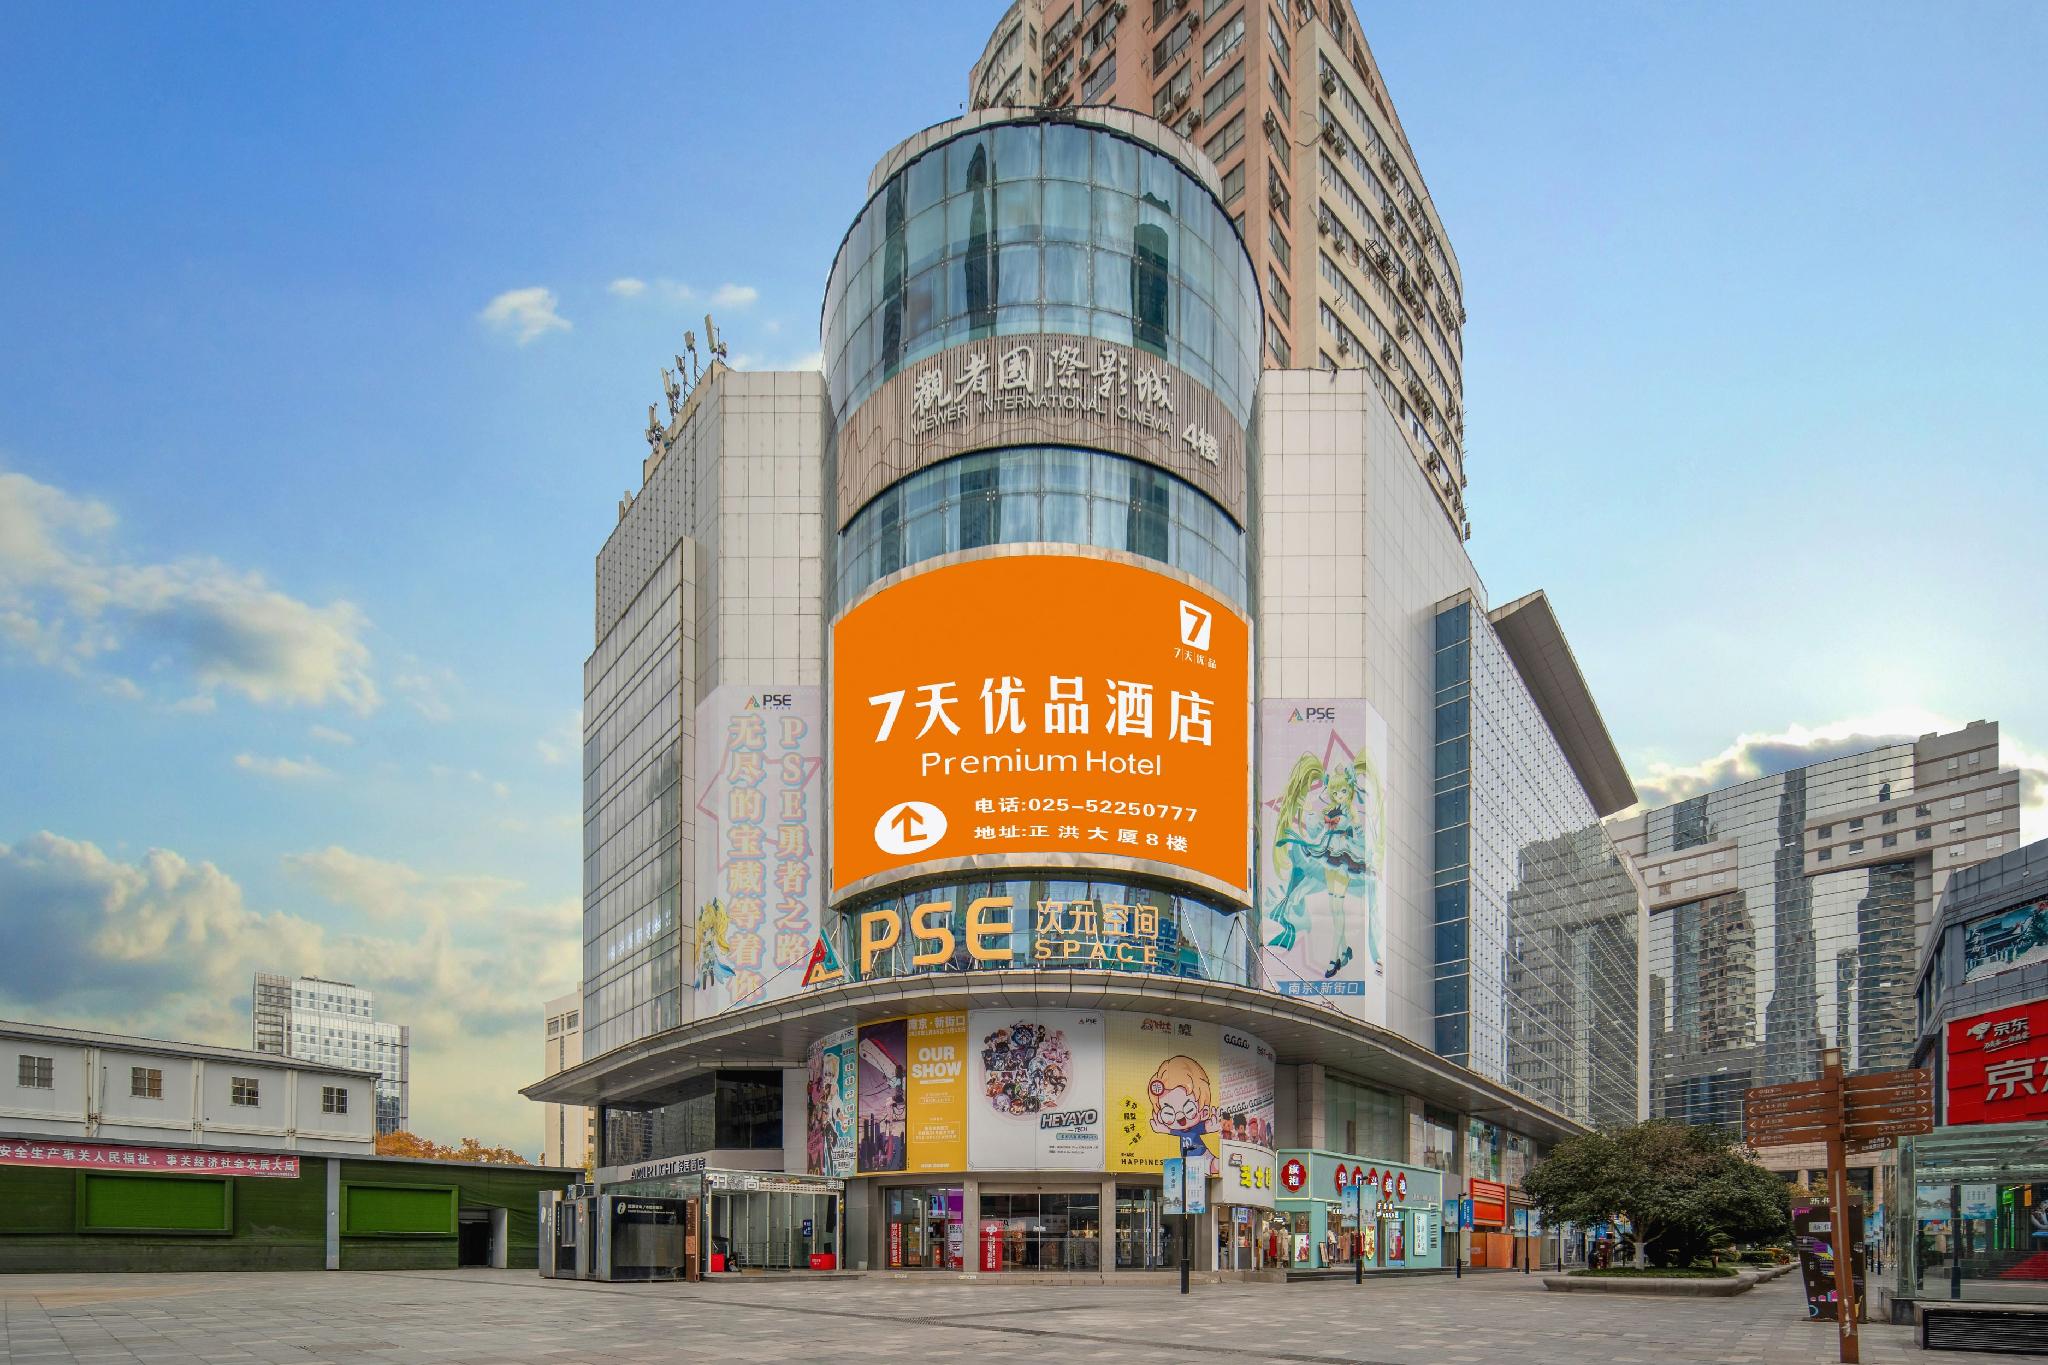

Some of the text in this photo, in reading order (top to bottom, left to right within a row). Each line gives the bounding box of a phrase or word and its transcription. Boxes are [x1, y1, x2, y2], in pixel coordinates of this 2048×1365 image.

[912, 394, 1171, 437] VIEWER INTERNATIONAL CINEMA
[1182, 423, 1218, 466] 4楼
[1173, 647, 1217, 669] 7天优品
[763, 694, 792, 706] PSE
[868, 675, 1215, 746] 7天优品酒店
[1305, 708, 1335, 719] PSE
[921, 748, 1161, 776] Premium Hotel
[1035, 898, 1159, 940] 次元空间
[861, 897, 1013, 974] PSE
[1035, 939, 1159, 966] SPACE
[1994, 1017, 2029, 1036] 京东
[918, 1046, 955, 1062] OUR
[912, 1061, 961, 1078] SHOW
[1985, 1056, 2048, 1101] 京
[1040, 1109, 1097, 1129] HEYAYO
[1121, 1158, 1164, 1166] HAPPINES
